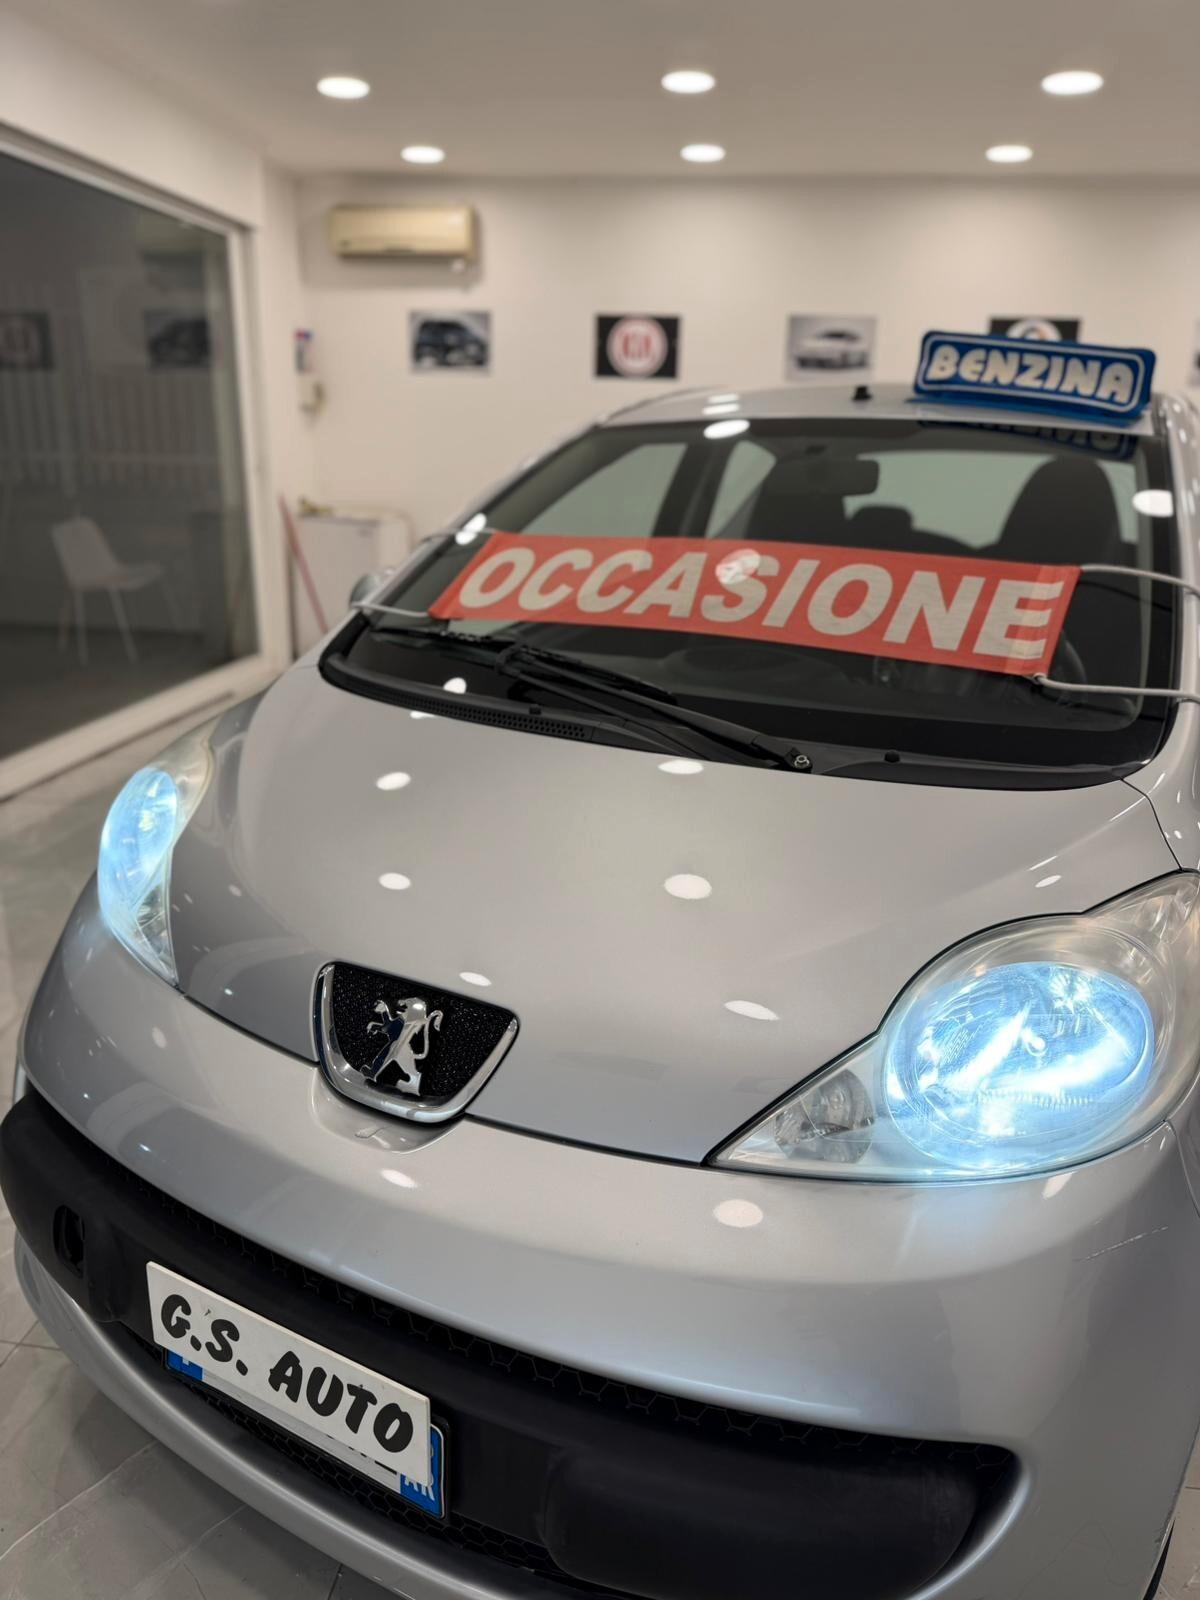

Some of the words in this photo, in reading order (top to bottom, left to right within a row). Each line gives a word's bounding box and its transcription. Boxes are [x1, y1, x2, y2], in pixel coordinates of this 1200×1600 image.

[925, 344, 1134, 405] BENZINA
[458, 547, 1064, 660] OCCASIONE
[160, 1294, 248, 1376] G.S.
[268, 1350, 413, 1453] AUTO
